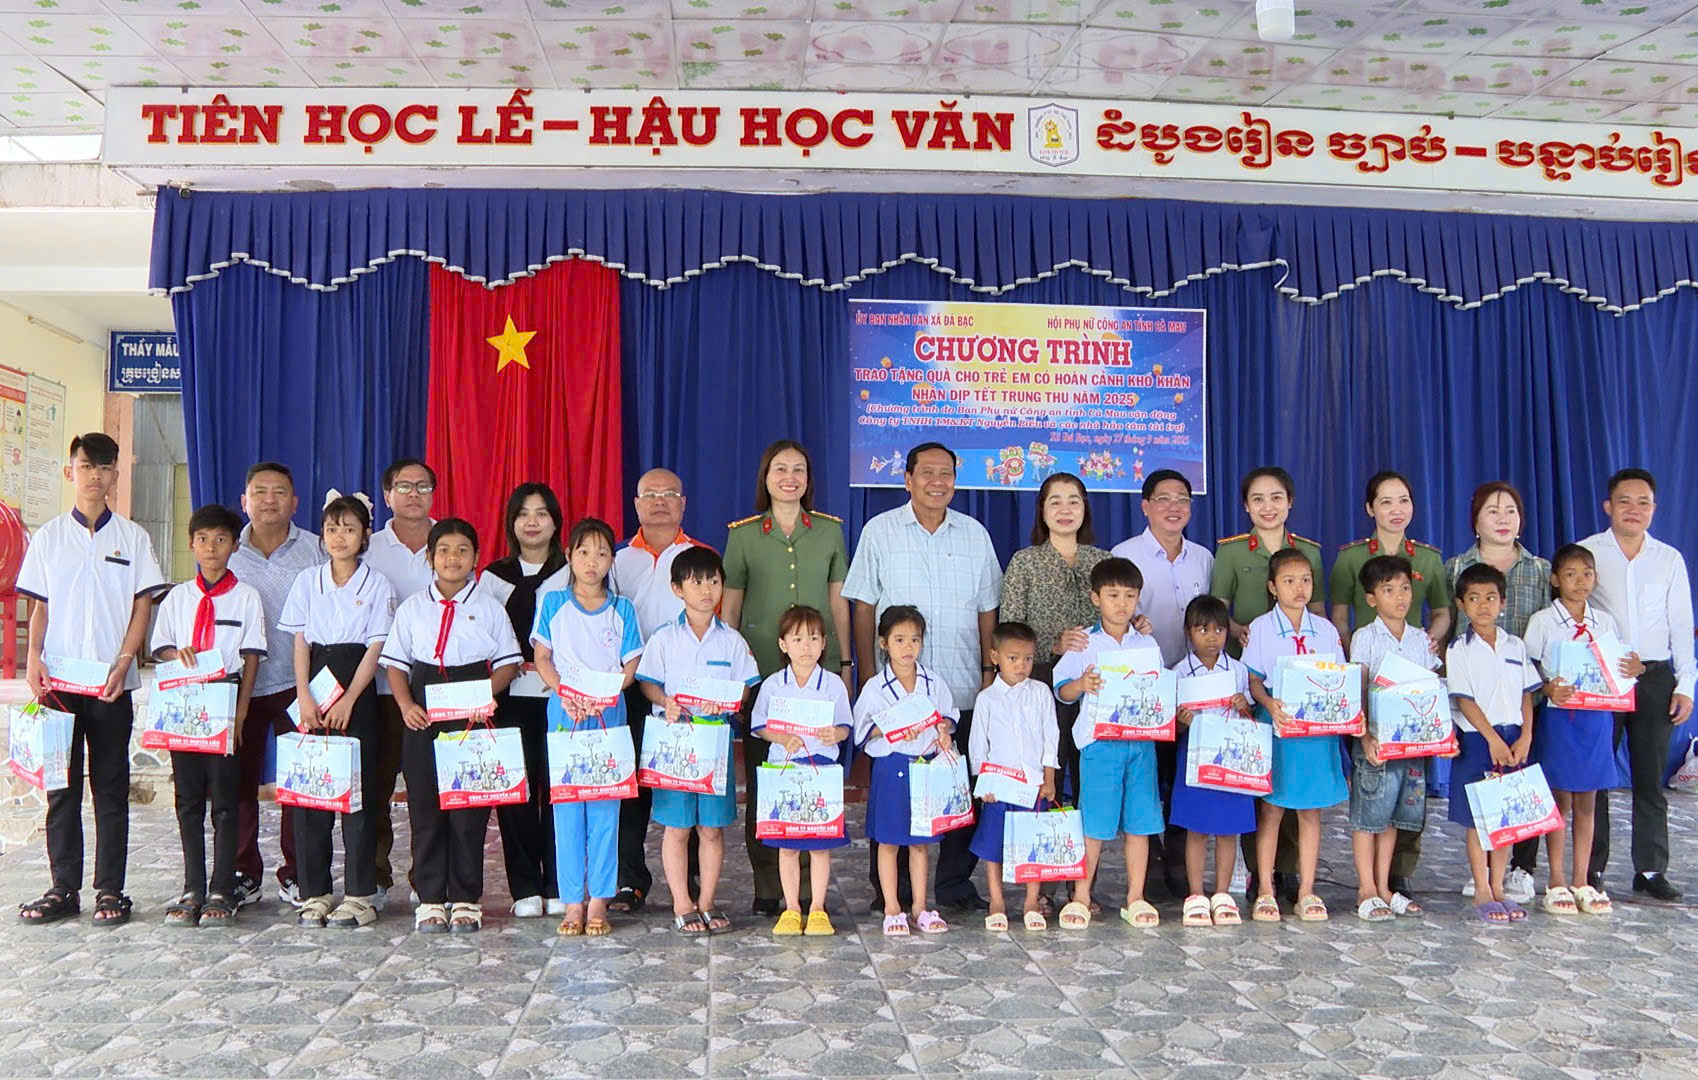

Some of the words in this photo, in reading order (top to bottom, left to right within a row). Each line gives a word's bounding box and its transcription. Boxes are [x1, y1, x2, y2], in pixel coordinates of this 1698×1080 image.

[142, 93, 283, 144] TIÊN
[304, 104, 439, 155] HỌC
[588, 96, 721, 156] HẬU
[740, 108, 874, 157] HỌC
[891, 100, 1015, 152] VĂN
[931, 312, 941, 325] XÃ
[957, 314, 974, 328] BẠC
[1047, 315, 1061, 331] HỘI
[1064, 318, 1080, 331] PHỤ
[1083, 317, 1094, 330] NỮ
[1097, 317, 1118, 330] CÔNG
[1121, 320, 1133, 331] AN
[1168, 321, 1187, 333] MAU
[122, 338, 153, 357] THẦY
[914, 334, 1040, 364] CHƯƠNG
[1047, 332, 1131, 366] TRÌNH
[855, 368, 888, 381] TRAO
[891, 368, 923, 384] TẶNG
[927, 368, 950, 383] QUÀ
[955, 370, 979, 382] CHO
[984, 367, 1007, 383] TRẺ
[1012, 372, 1030, 384] EM
[1034, 370, 1050, 384] CÓ
[1055, 370, 1087, 385] HOÀN
[1091, 370, 1124, 386] CẢNH
[1128, 372, 1153, 387] KHÓ
[912, 386, 946, 400] NHÂN
[950, 389, 970, 402] DỊP
[974, 386, 997, 401] TẾT
[1002, 390, 1041, 403] TRUNG
[1045, 391, 1069, 404] THU
[1073, 390, 1100, 404] NĂM
[1104, 392, 1135, 406] 2025
[858, 416, 886, 427] Công
[889, 416, 899, 427] ty
[912, 404, 938, 414] trình
[941, 405, 955, 414] do
[957, 406, 977, 415] Ban
[980, 406, 1000, 416] Phụ
[1020, 407, 1046, 417] Công
[1051, 409, 1061, 417] an
[1105, 409, 1126, 418] Mau
[1149, 410, 1177, 420] động
